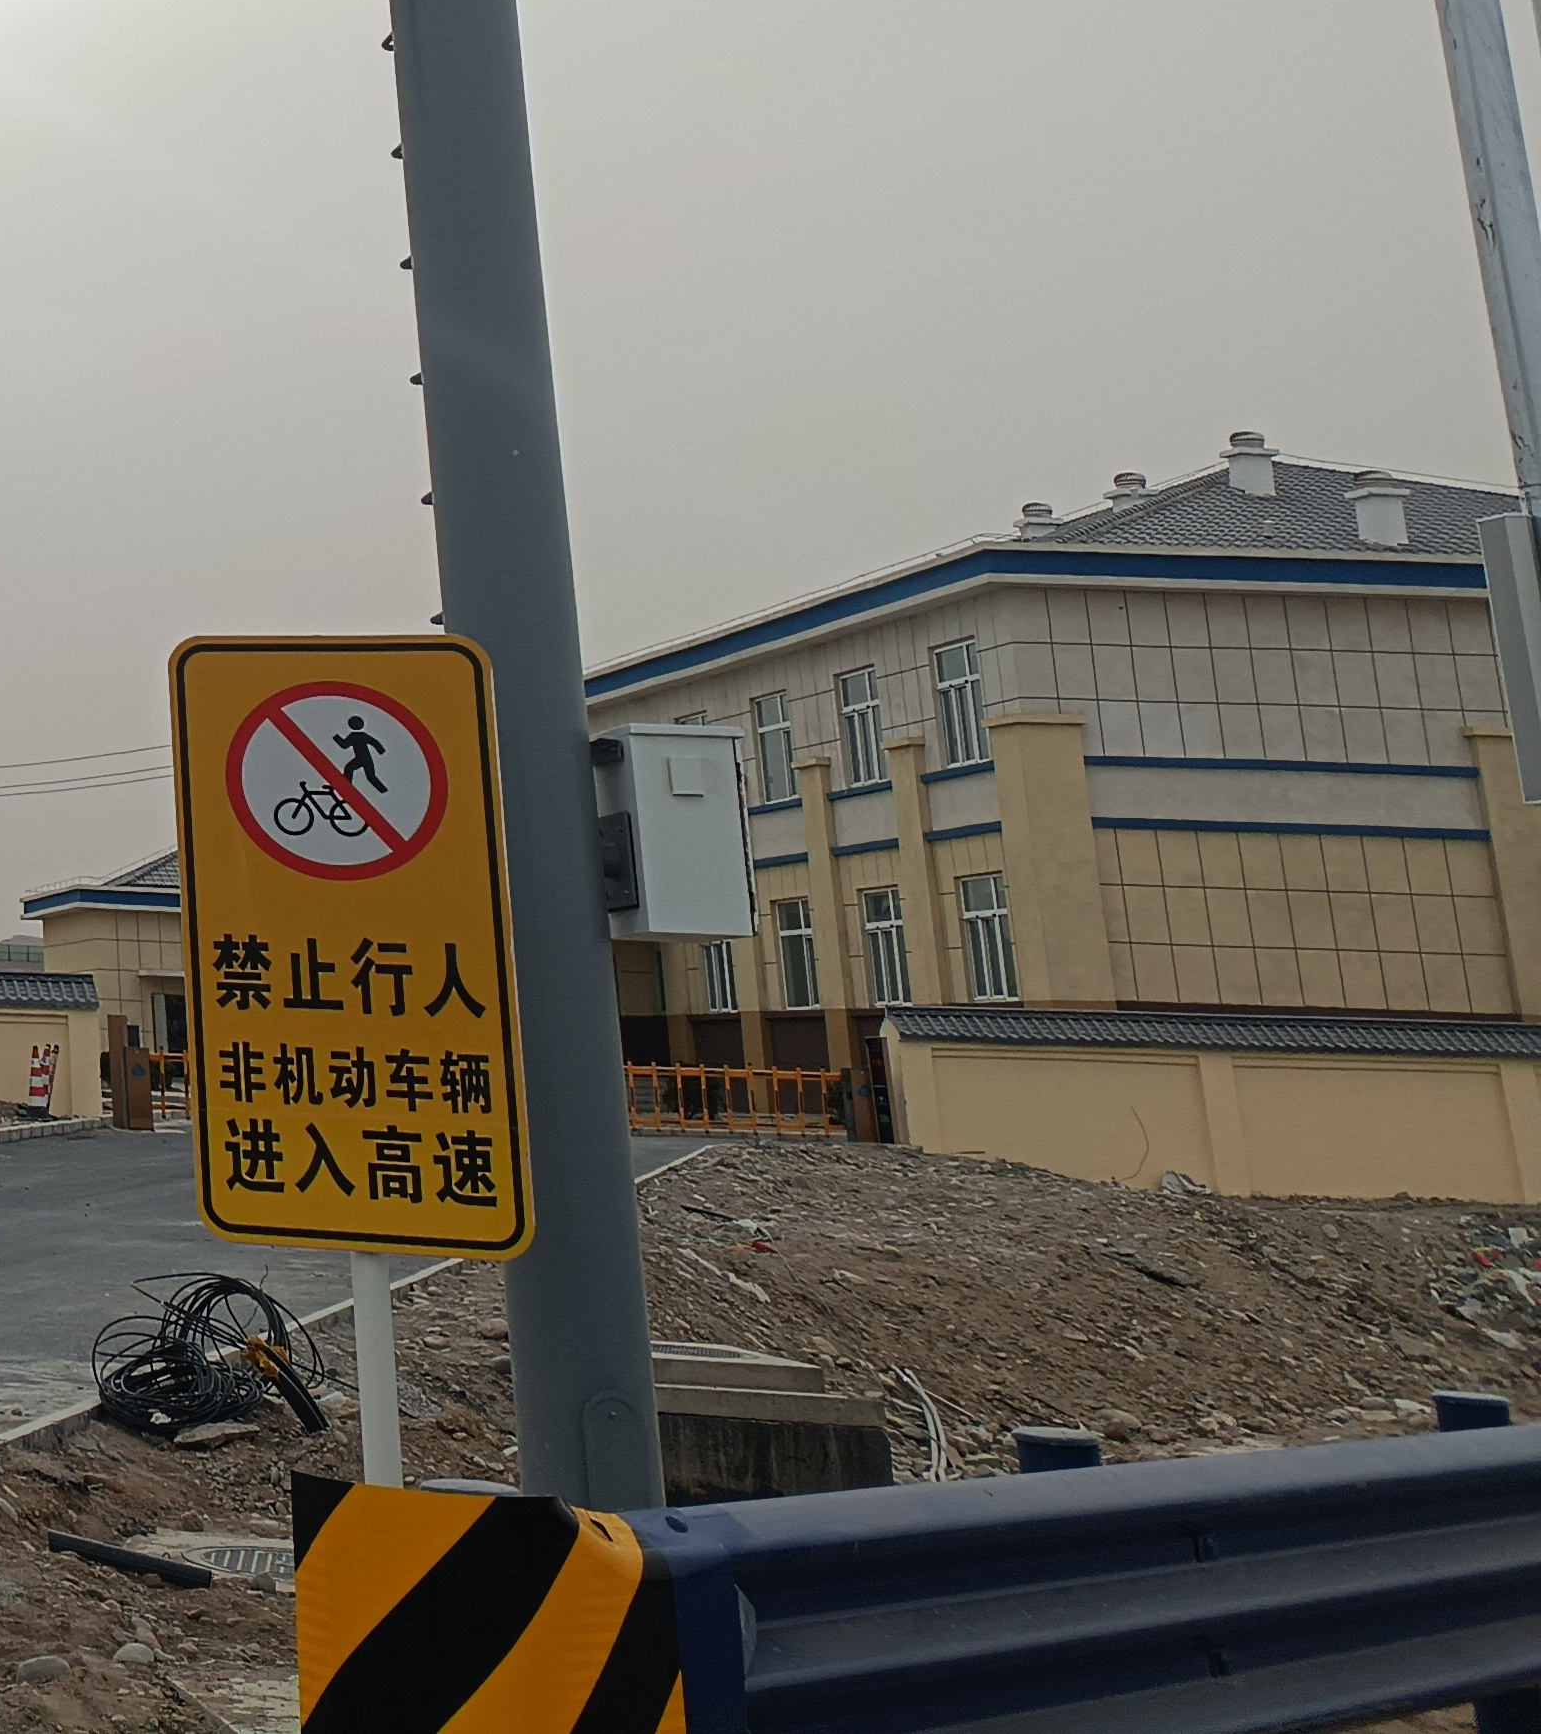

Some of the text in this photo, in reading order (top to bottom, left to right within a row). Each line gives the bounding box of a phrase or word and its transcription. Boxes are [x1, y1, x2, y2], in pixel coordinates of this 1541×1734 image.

[213, 934, 486, 1019] 禁止行人
[219, 1041, 492, 1114] 非机动车辆
[225, 1118, 497, 1208] 进入高速
